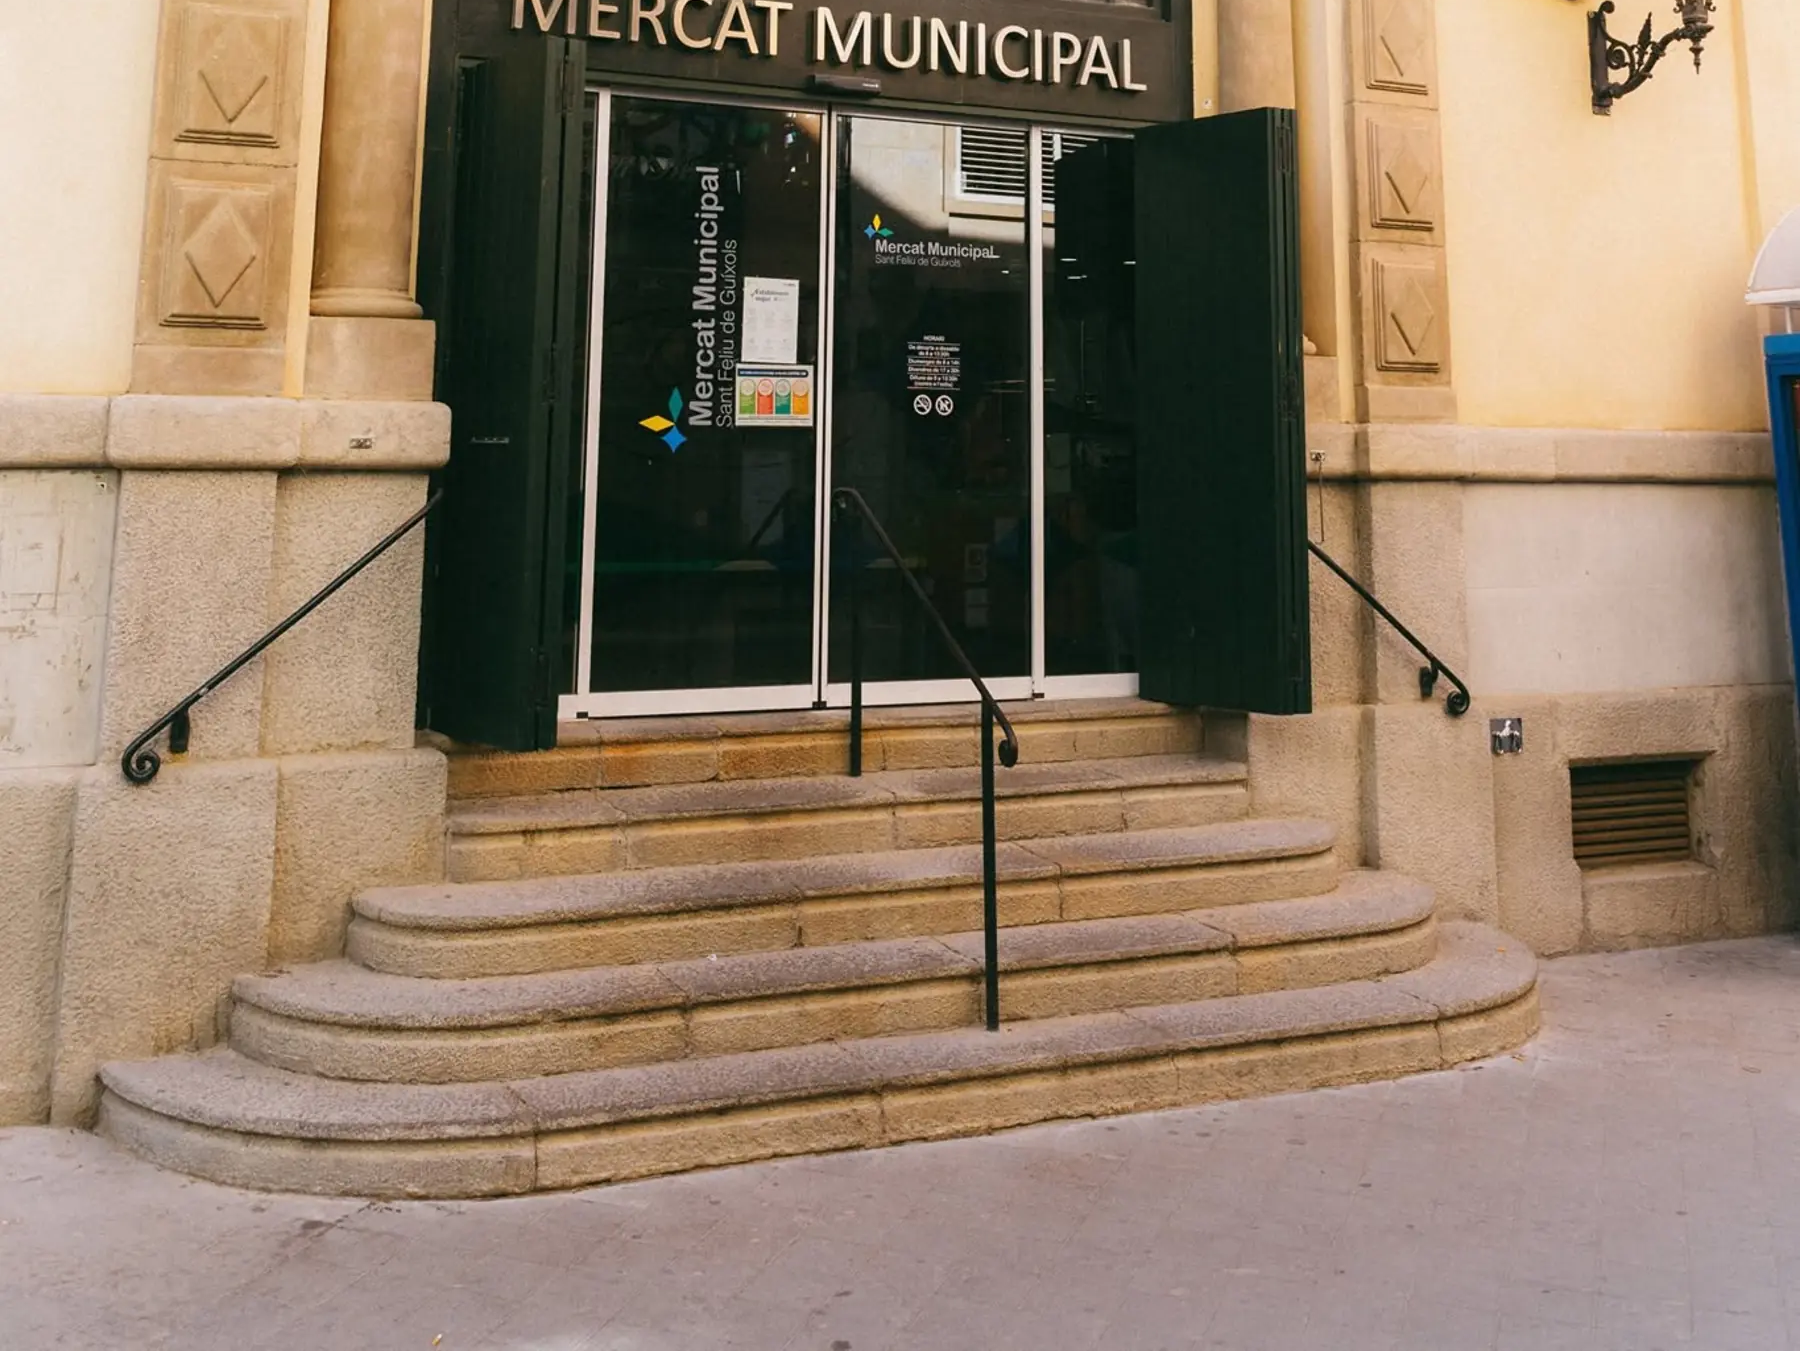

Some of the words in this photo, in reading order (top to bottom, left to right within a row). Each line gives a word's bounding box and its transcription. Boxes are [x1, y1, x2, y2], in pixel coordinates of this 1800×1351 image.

[811, 6, 1147, 91] MUNICIPAL
[692, 166, 725, 310] Municipal
[875, 238, 925, 255] Mercat
[928, 241, 994, 261] Municipal
[720, 239, 737, 305] Guíxols
[875, 254, 896, 264] Sant
[896, 254, 916, 265] Feliu
[918, 256, 929, 266] de
[720, 310, 736, 334] de
[688, 318, 716, 426] Mercat
[718, 339, 735, 381] Feliu
[716, 387, 733, 427] Sant
